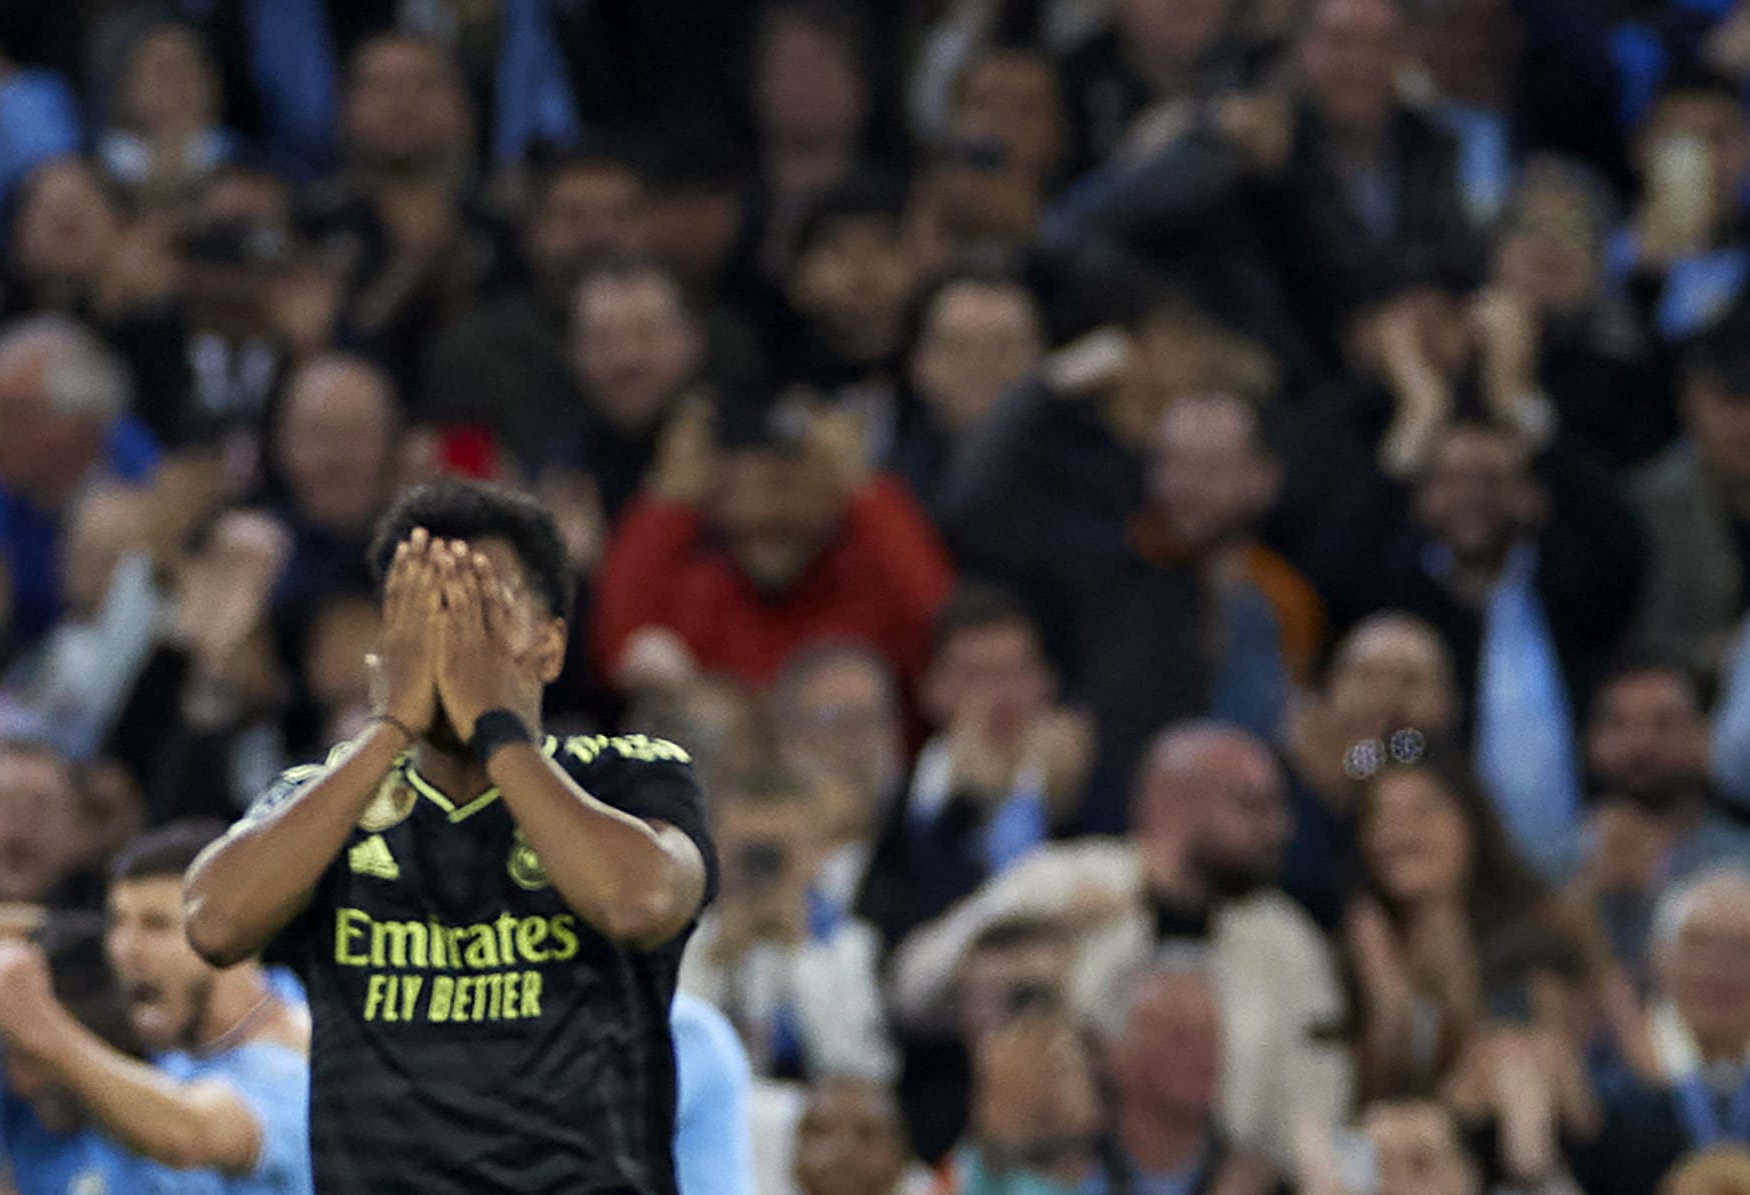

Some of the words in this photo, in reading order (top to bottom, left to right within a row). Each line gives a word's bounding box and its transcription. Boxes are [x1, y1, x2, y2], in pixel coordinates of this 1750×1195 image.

[334, 907, 580, 969] Emirates
[363, 974, 424, 1022] FLY
[427, 970, 544, 1022] BETTER
